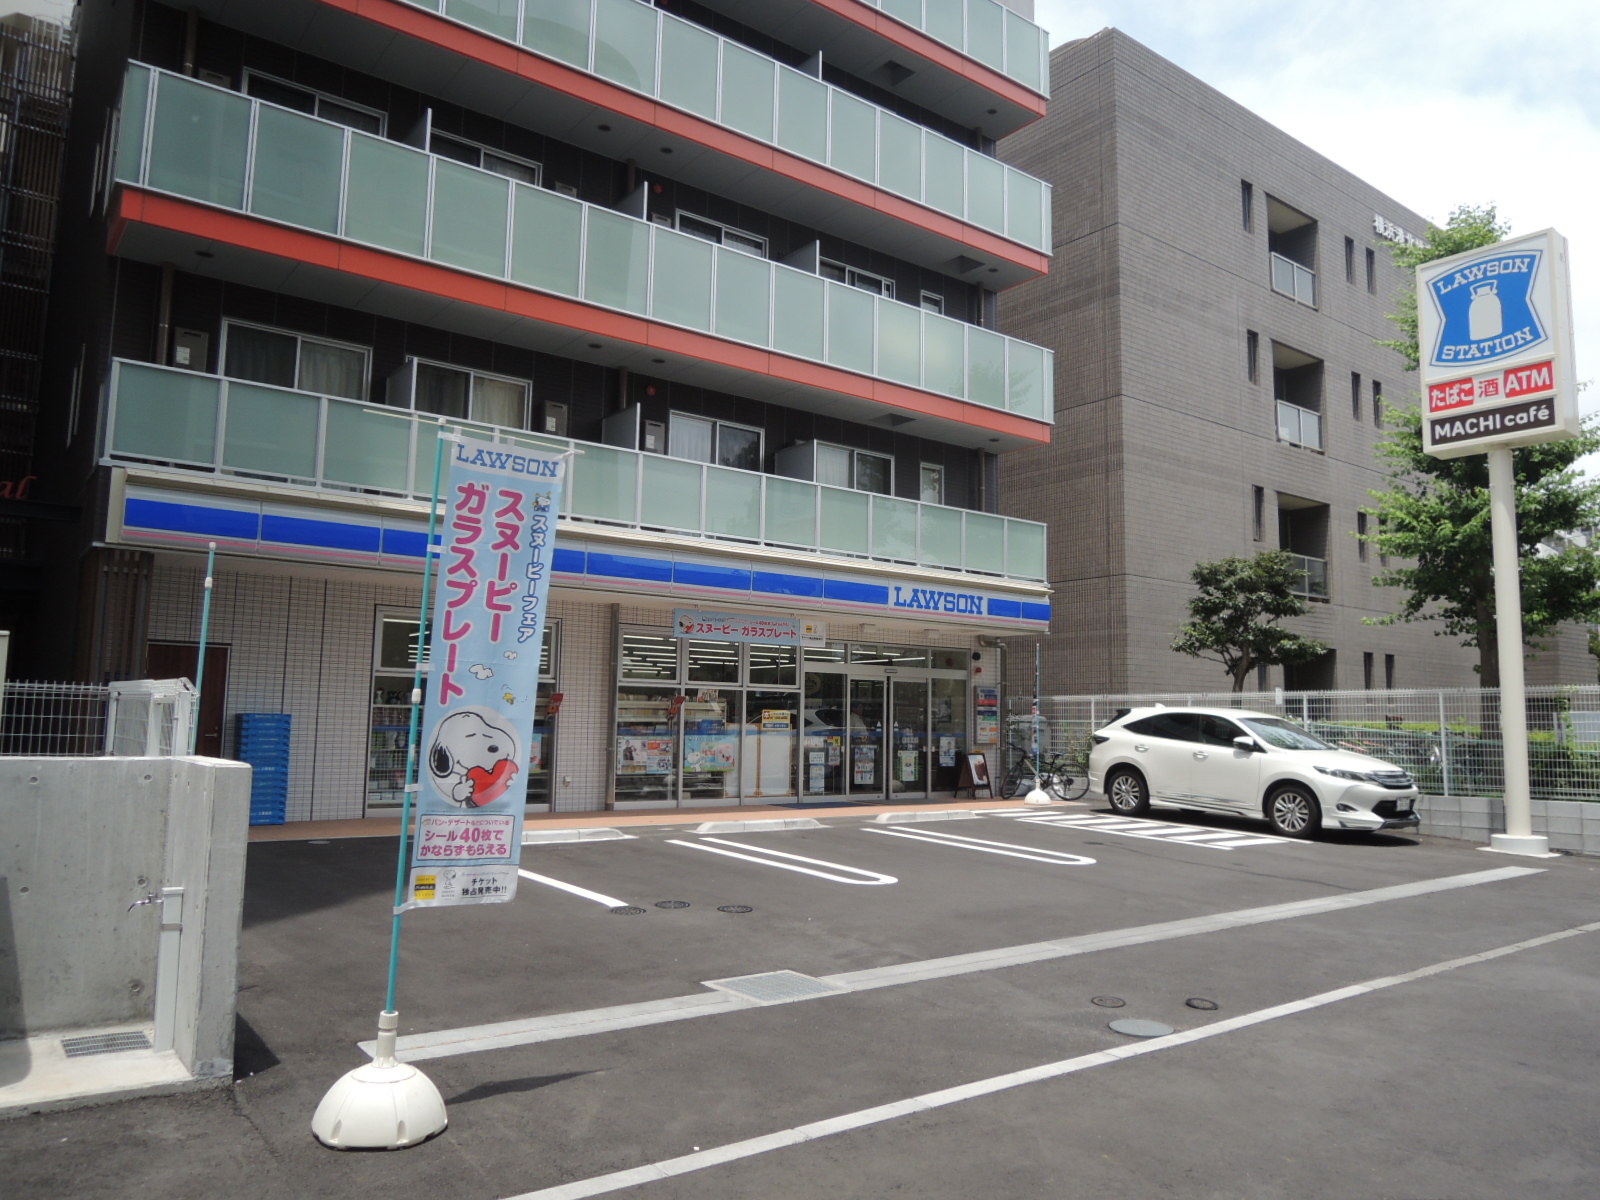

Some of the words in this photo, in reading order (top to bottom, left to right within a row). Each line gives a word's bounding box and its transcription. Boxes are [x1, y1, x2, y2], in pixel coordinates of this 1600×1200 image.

[1437, 257, 1531, 295] LAWSON
[1441, 326, 1534, 360] STATION
[1431, 383, 1475, 409] たばこ
[1478, 377, 1499, 398] 酒
[1505, 367, 1550, 393] ATM
[1434, 415, 1500, 440] MACHI
[1504, 404, 1550, 428] café
[456, 444, 559, 478] LAWSON
[485, 489, 525, 643] スヌーピー
[517, 515, 548, 643] スヌーピーフェア
[439, 482, 491, 706] ガラスプレート
[894, 586, 984, 615] LAWSON
